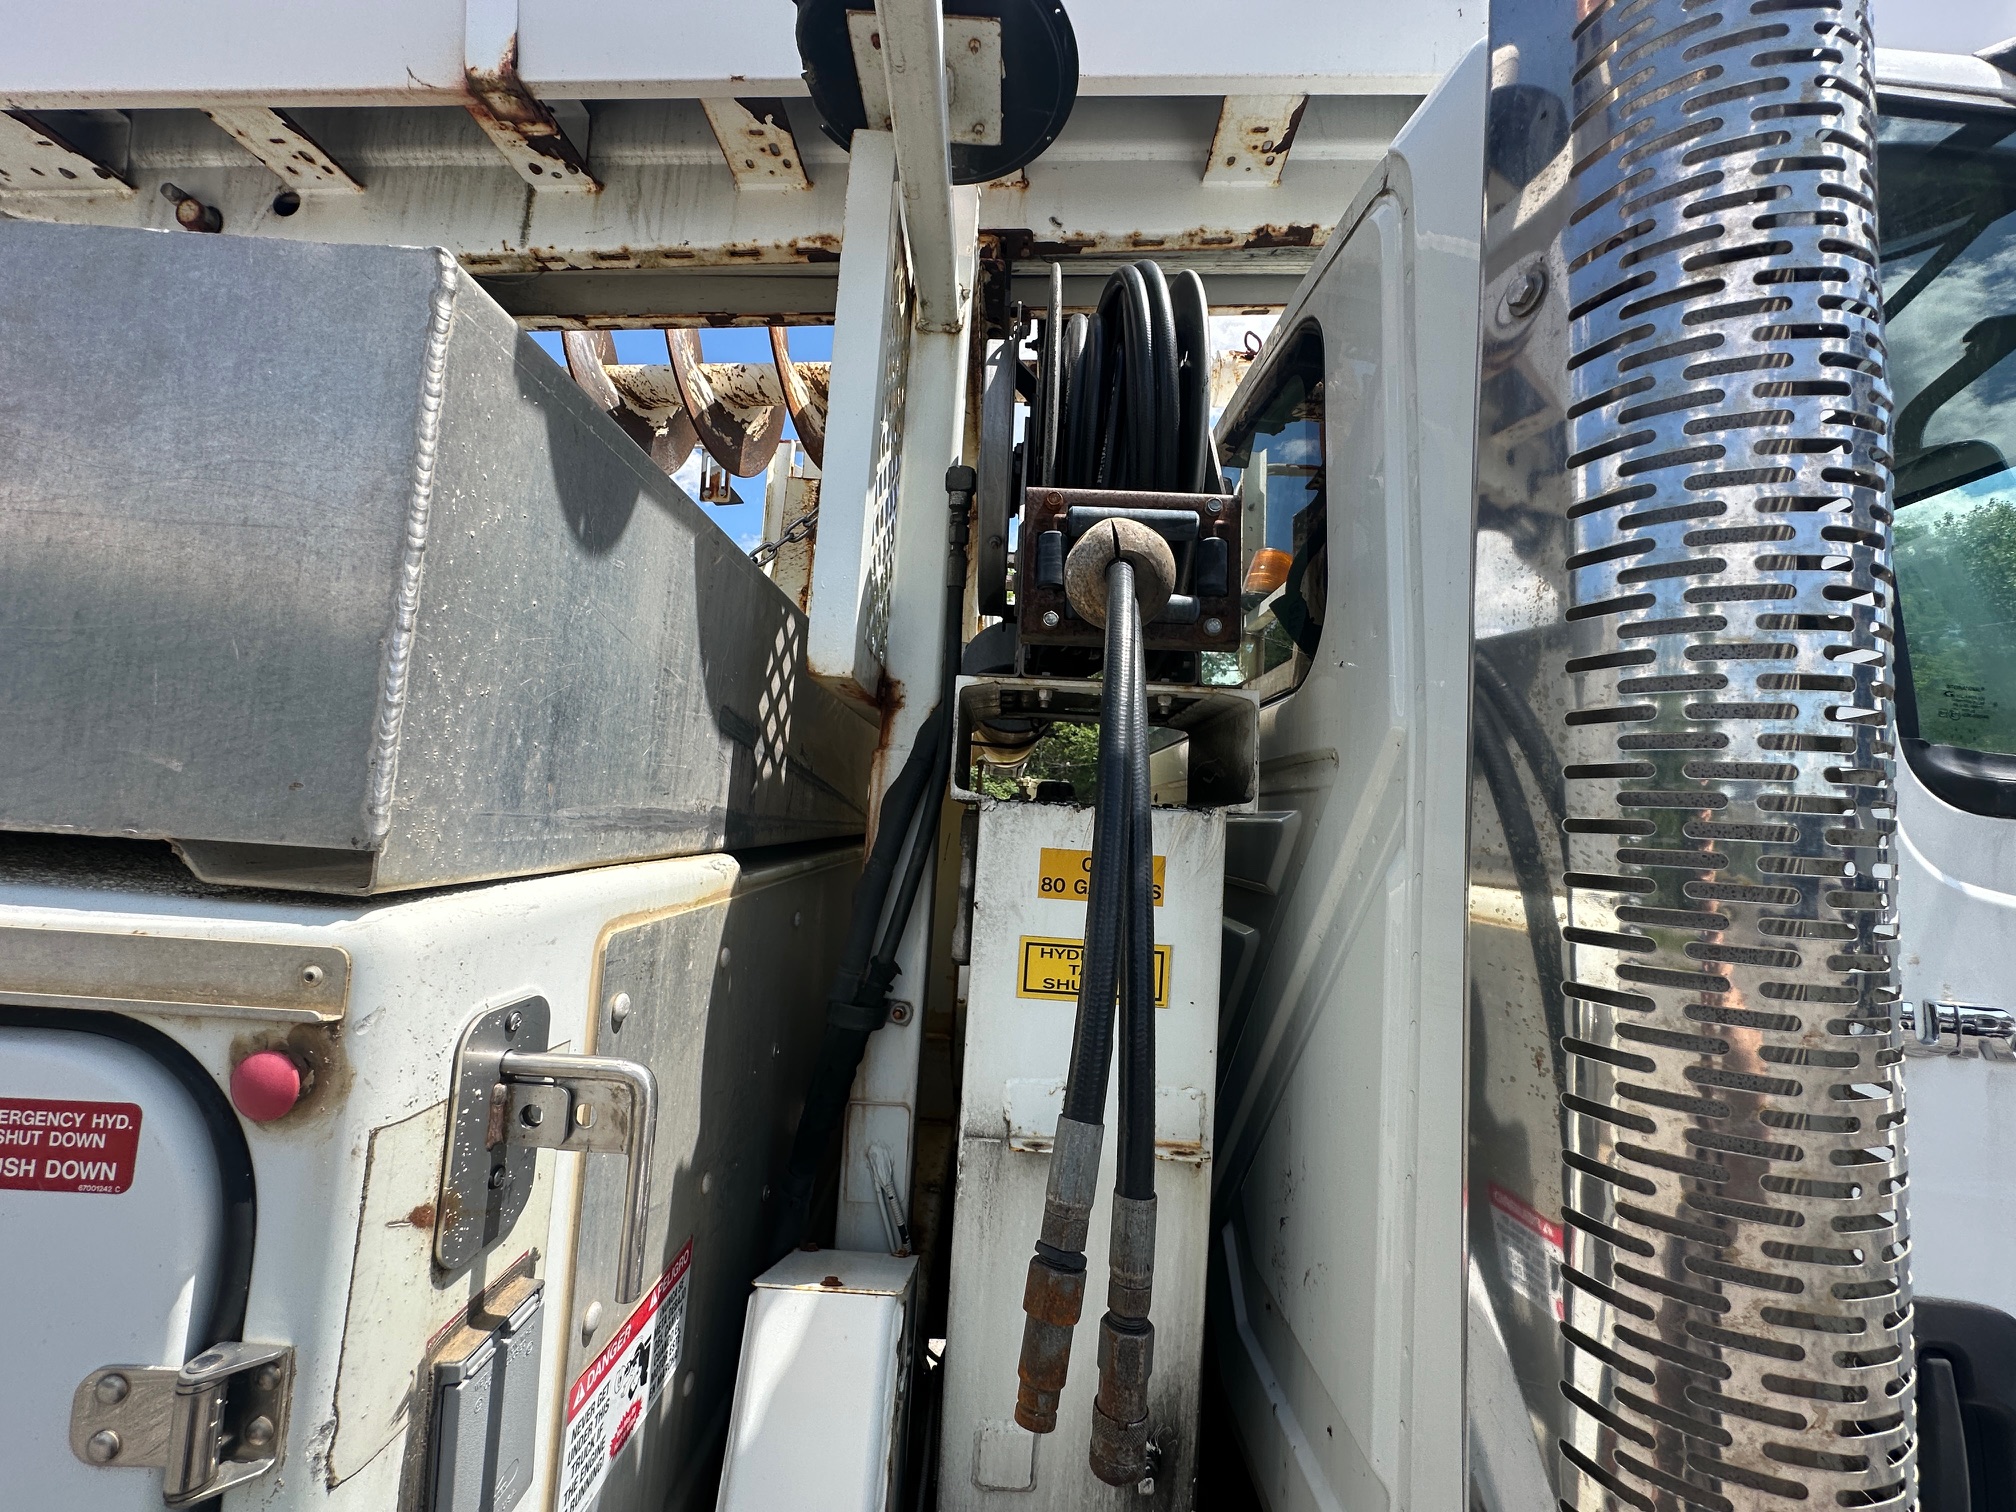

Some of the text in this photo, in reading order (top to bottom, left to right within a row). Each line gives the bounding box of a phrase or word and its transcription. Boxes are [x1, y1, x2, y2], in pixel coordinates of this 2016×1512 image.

[1041, 877, 1066, 893] 80
[1043, 978, 1080, 990] SHU
[0, 1109, 133, 1130] ERGENCY HYD.
[48, 1131, 106, 1148] DOWN
[0, 1157, 117, 1181] SH DOWN
[115, 1185, 121, 1193] C
[658, 1249, 689, 1299] PELIGRO
[587, 1324, 632, 1391] DANGER
[571, 1380, 611, 1444] NEVER GET
[567, 1398, 610, 1466] UNDER THIS
[571, 1422, 604, 1479] TRUCK IF
[564, 1435, 606, 1507] THE ENGINE
